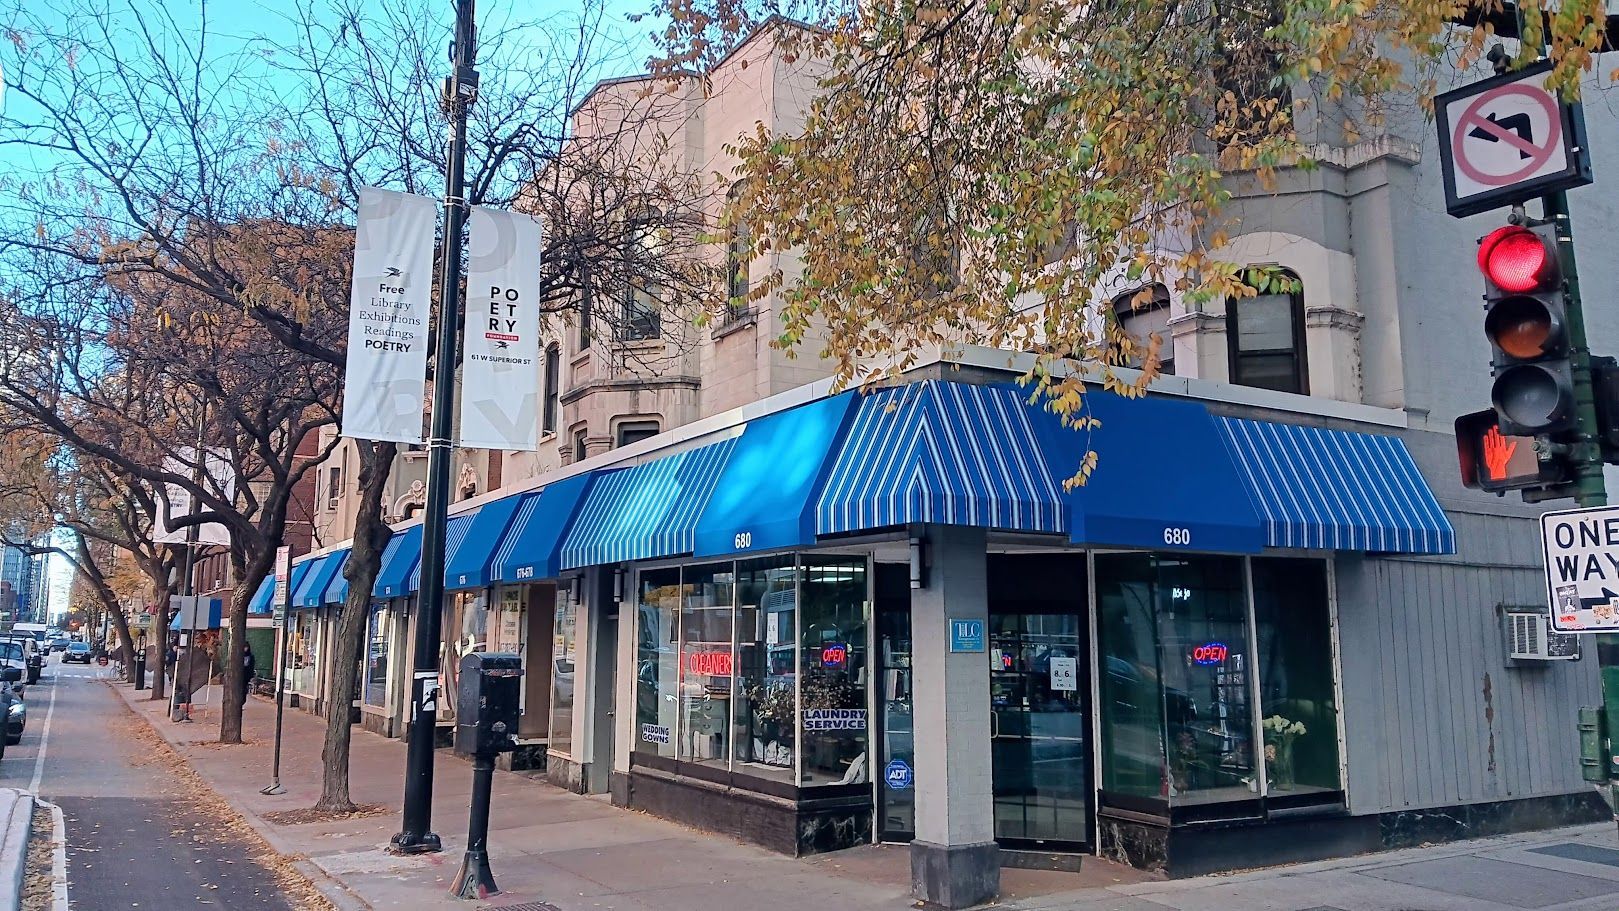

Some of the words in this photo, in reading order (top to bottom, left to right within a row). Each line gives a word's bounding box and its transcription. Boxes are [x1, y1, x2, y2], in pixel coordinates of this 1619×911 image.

[379, 283, 405, 295] Free
[371, 297, 411, 312] Library
[359, 310, 421, 326] Exhibitions
[364, 326, 414, 340] Readings
[365, 339, 411, 353] POETRY
[489, 355, 522, 364] SUPERIOR
[735, 532, 751, 549] 680
[1164, 527, 1191, 545] 680
[1555, 519, 1619, 549] ONE
[1555, 552, 1619, 582] WAY
[822, 649, 845, 662] OPEN
[1194, 646, 1227, 660] OPEN
[804, 709, 866, 719] LAUNDRY
[643, 724, 669, 736] WEDDING
[805, 719, 865, 729] SERVICE
[643, 732, 669, 744] GOWNS
[889, 769, 907, 780] ADT
